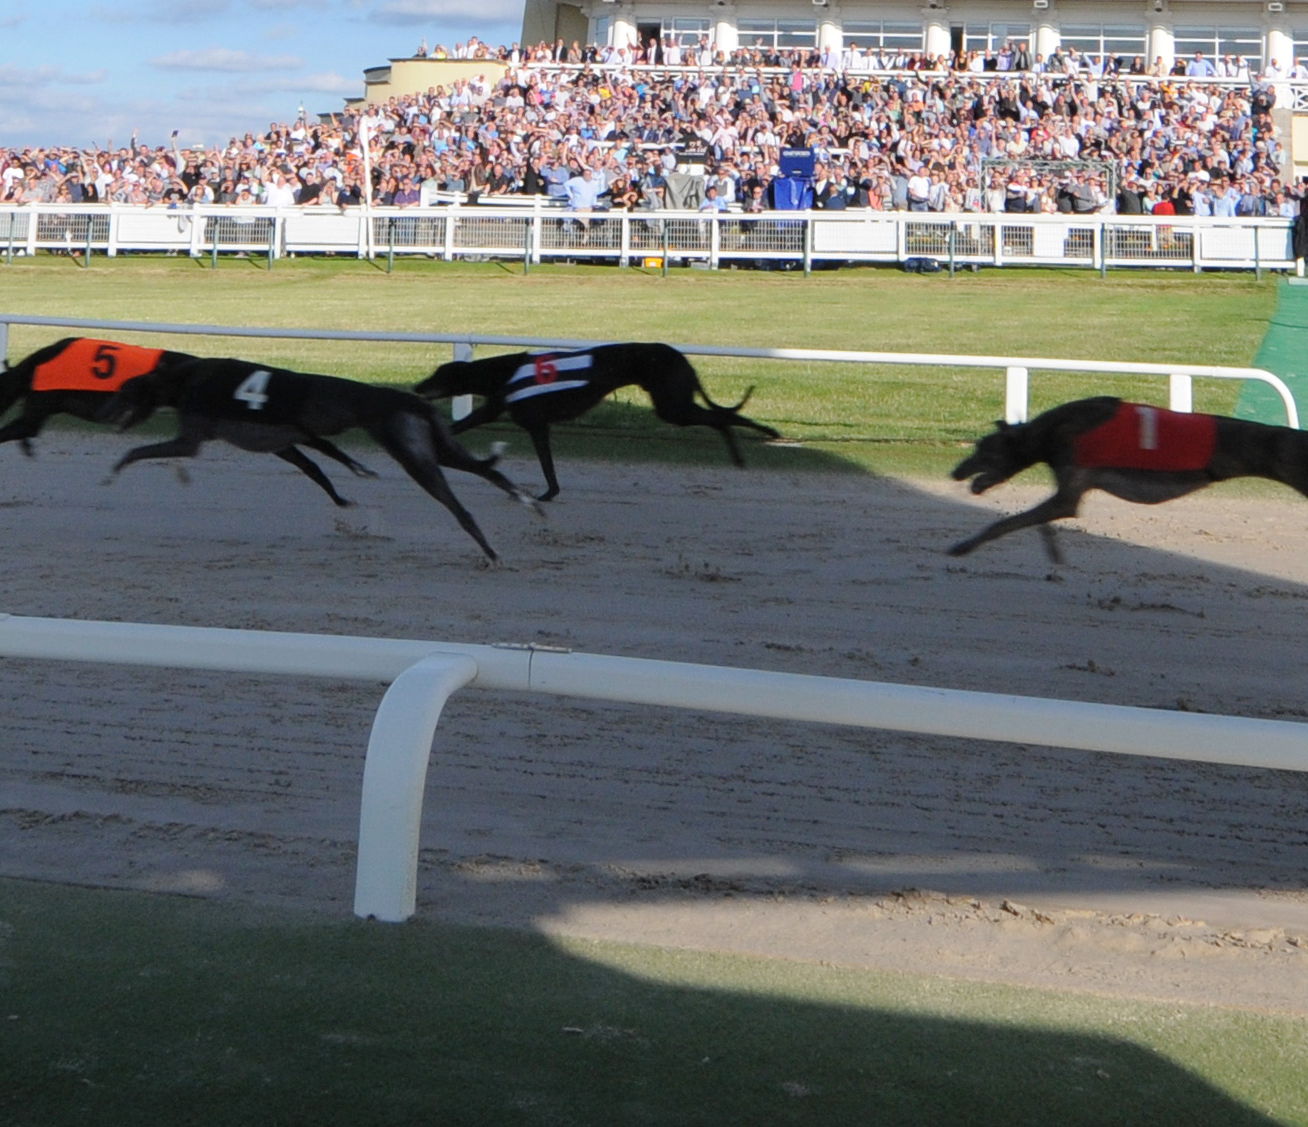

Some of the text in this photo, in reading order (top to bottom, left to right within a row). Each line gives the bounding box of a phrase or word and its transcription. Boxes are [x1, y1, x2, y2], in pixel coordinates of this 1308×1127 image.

[92, 345, 121, 379] 5
[534, 353, 559, 384] 6
[233, 370, 272, 410] 4
[1134, 406, 1158, 450] 1
